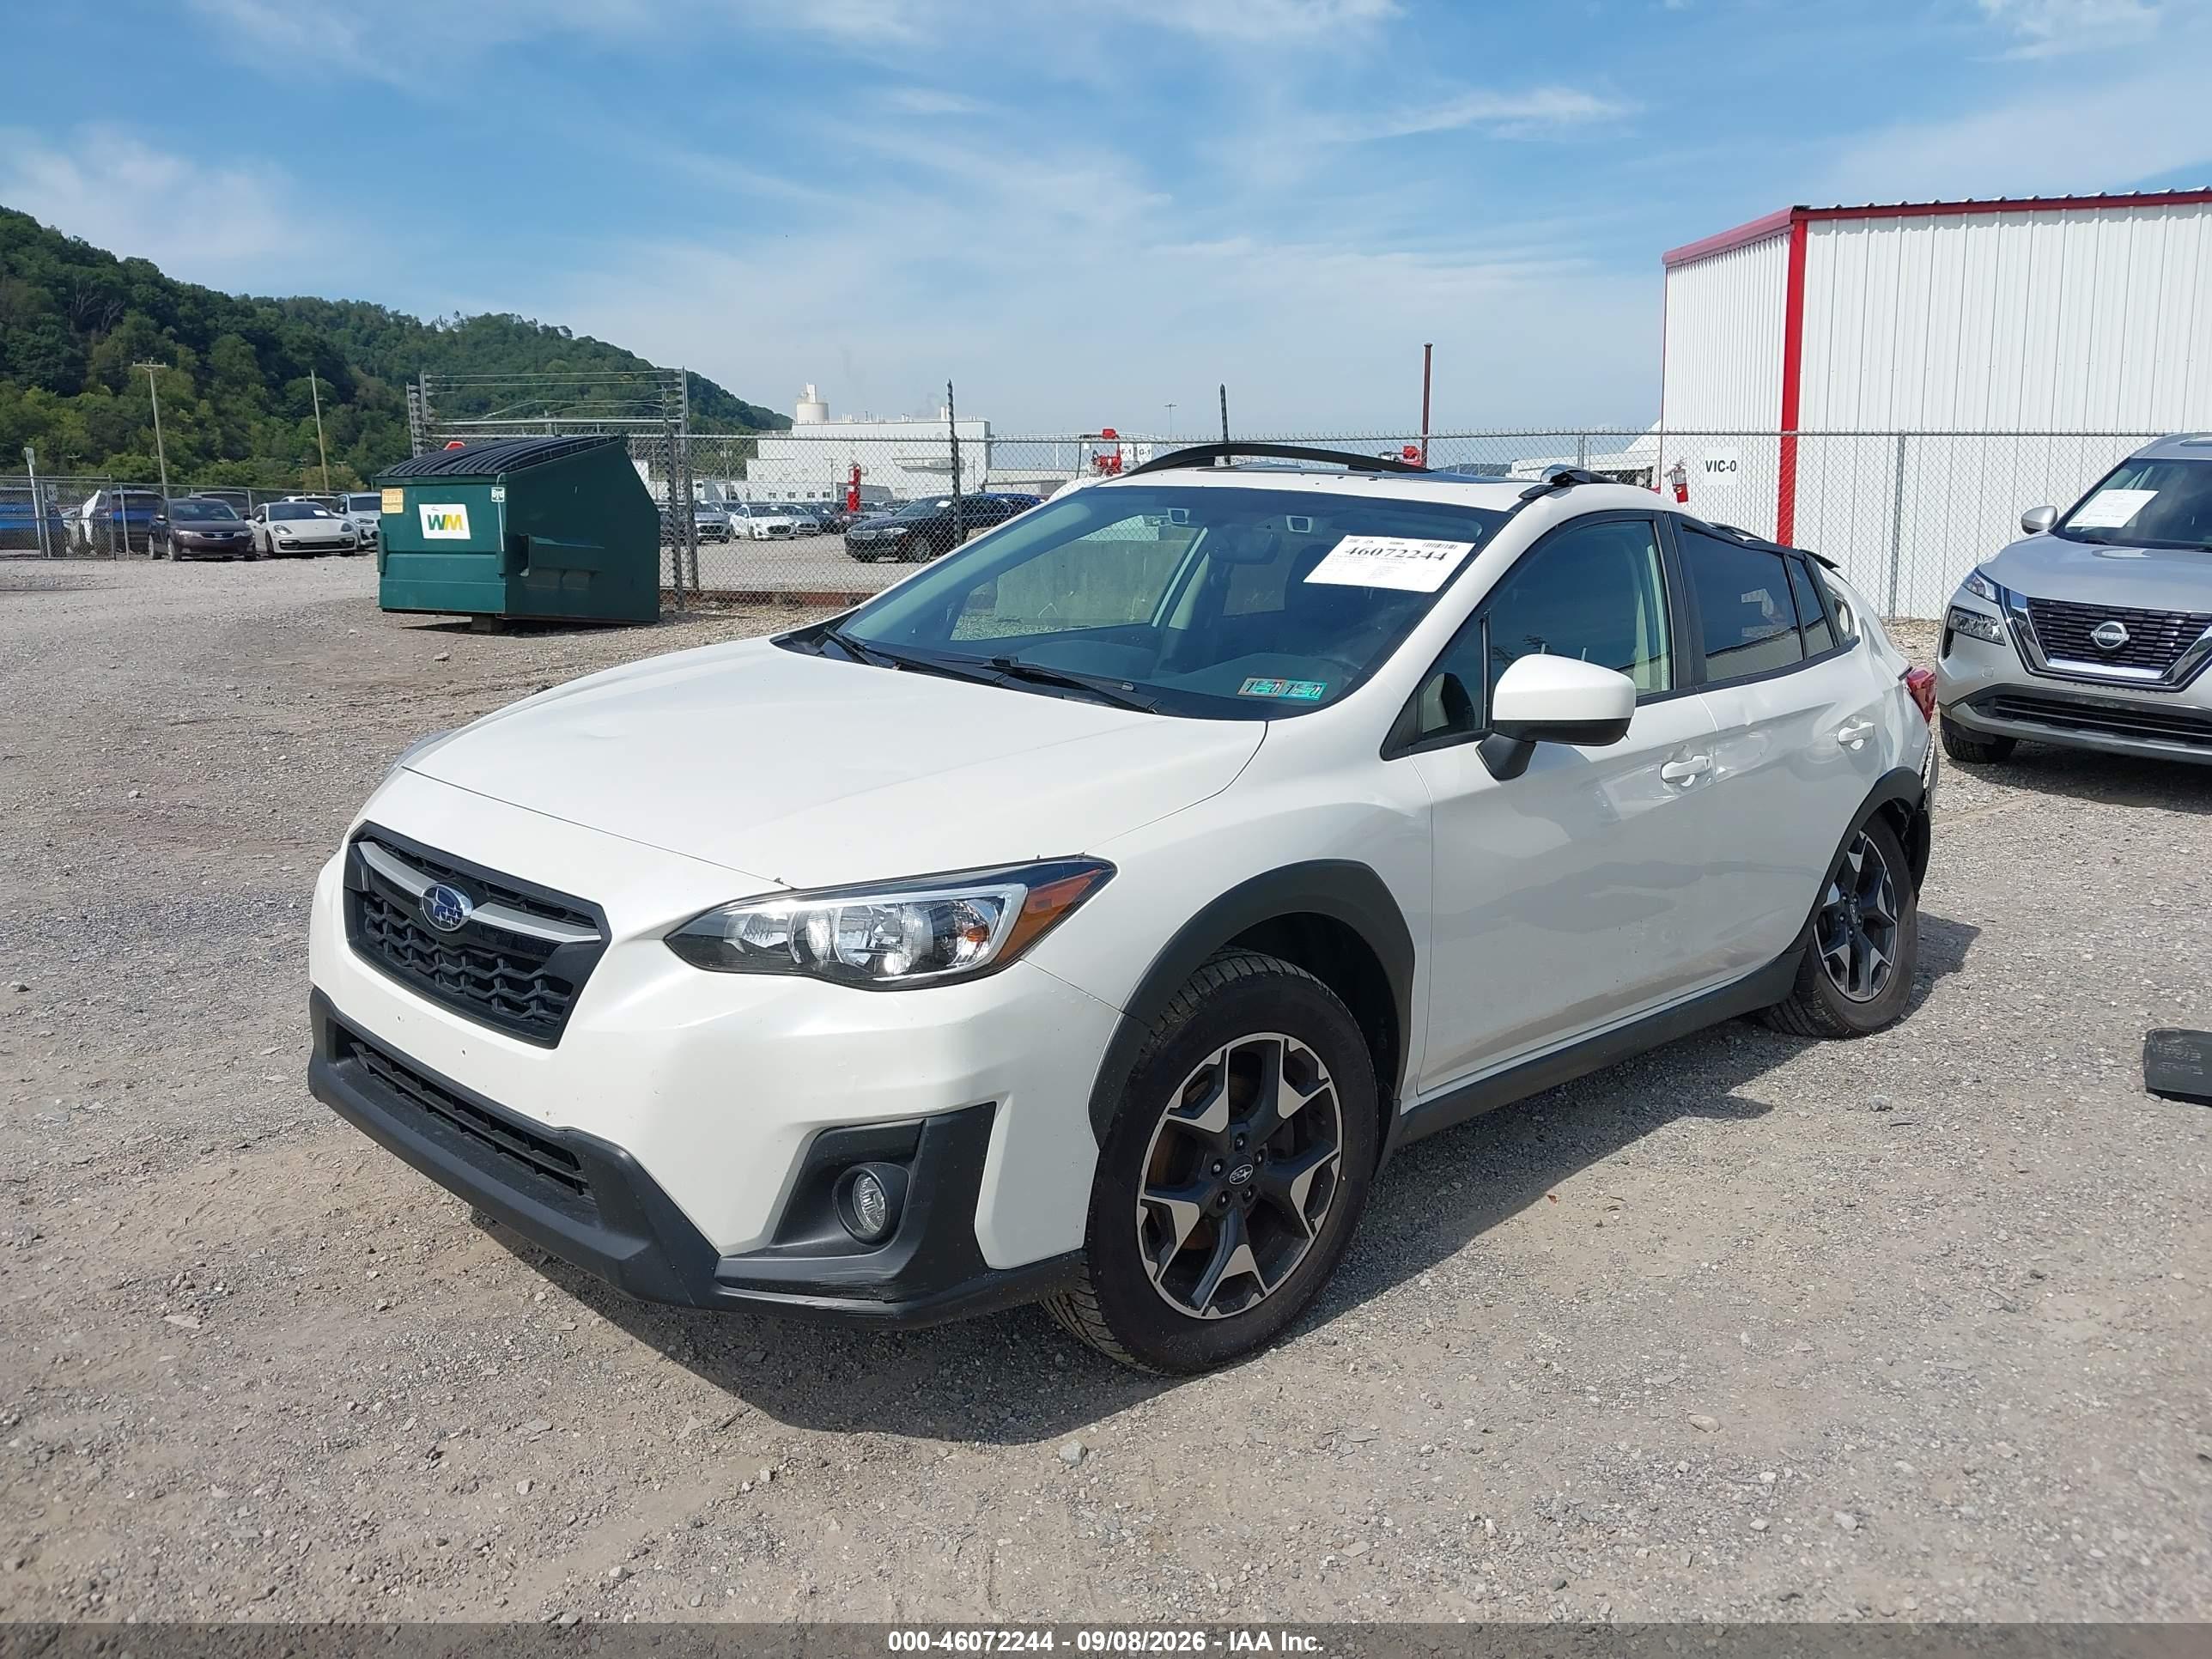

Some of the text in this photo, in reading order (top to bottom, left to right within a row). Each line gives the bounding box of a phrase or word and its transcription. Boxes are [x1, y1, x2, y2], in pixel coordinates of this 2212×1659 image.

[427, 514, 465, 531] WM
[1344, 546, 1448, 561] 46072244
[2090, 630, 2130, 641] NISSAN
